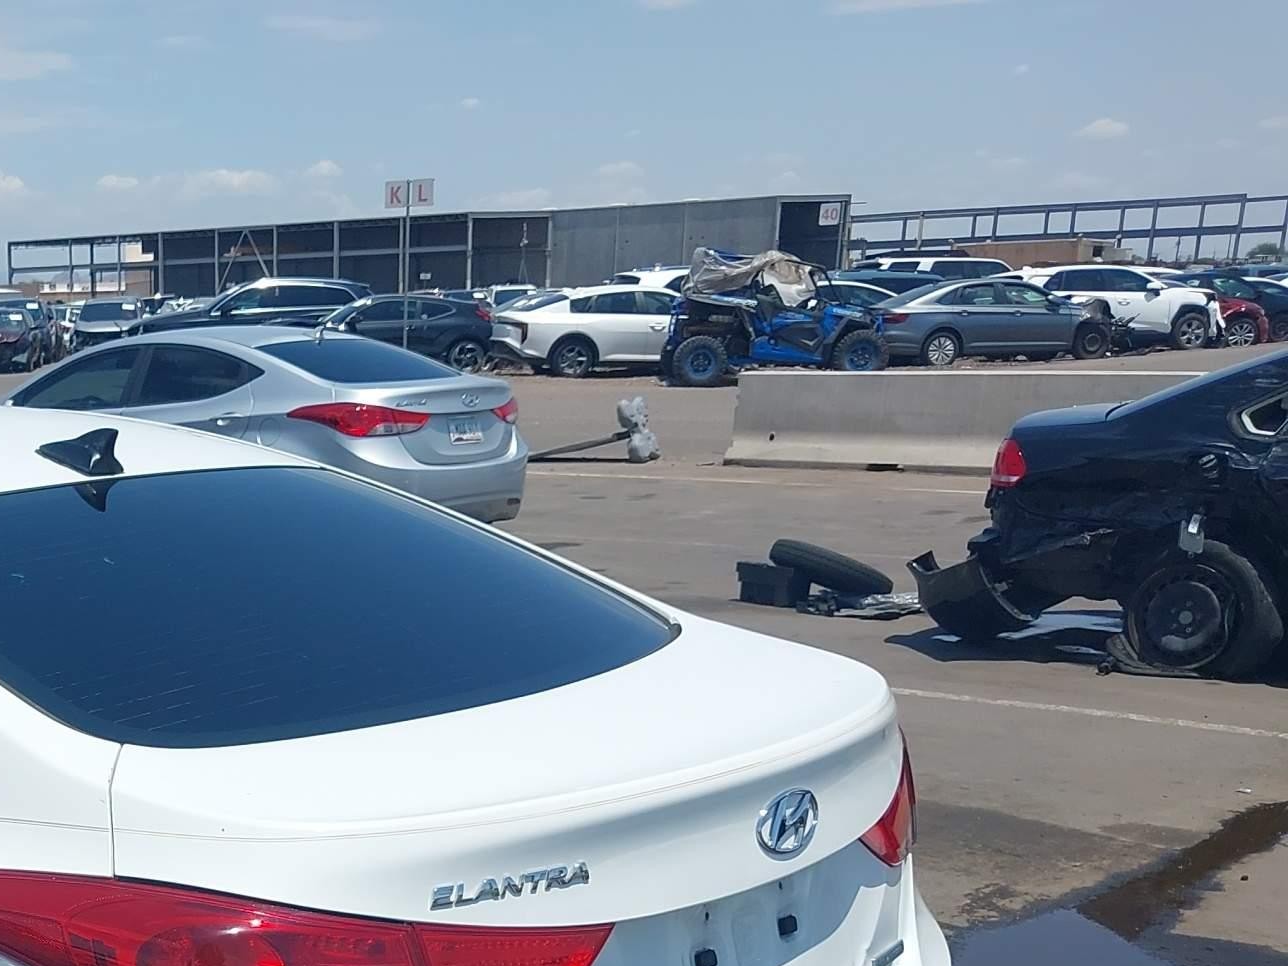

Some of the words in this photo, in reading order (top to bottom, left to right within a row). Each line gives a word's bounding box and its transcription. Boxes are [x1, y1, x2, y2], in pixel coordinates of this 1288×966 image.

[390, 185, 402, 205] K
[418, 184, 429, 203] L
[823, 207, 839, 221] 40
[429, 860, 590, 912] ELANTRA
